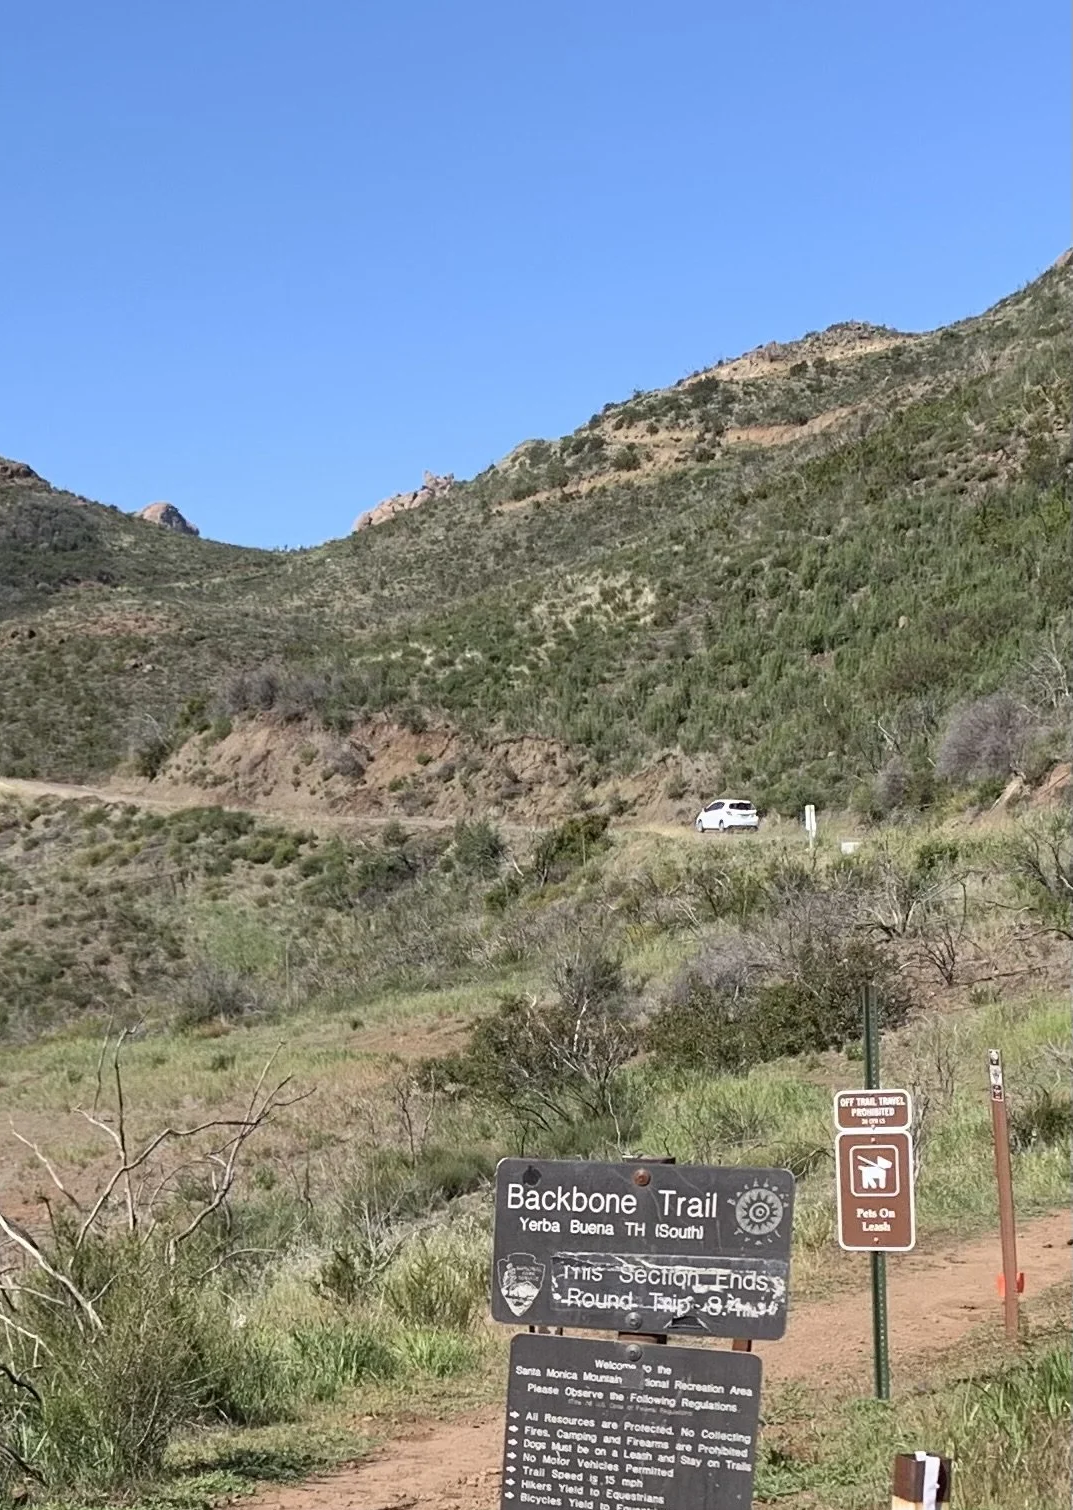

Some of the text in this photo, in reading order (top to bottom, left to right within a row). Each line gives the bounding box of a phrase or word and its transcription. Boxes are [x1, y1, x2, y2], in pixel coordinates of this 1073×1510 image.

[840, 1097, 905, 1107] OFF TRAIL TRAVEL
[851, 1108, 894, 1117] PROHIBITED
[507, 1183, 637, 1215] Backbone
[659, 1190, 717, 1219] Trail
[856, 1208, 895, 1218] Pets On
[519, 1217, 704, 1240] Yerba Buena TH (South)
[862, 1222, 890, 1232] Leash
[619, 1267, 699, 1289] Section
[716, 1271, 768, 1291] Ends
[567, 1288, 633, 1308] Round
[595, 1360, 672, 1375] Welcome to the
[515, 1366, 541, 1377] Santa
[546, 1369, 578, 1380] Monica
[583, 1372, 623, 1384] Mountain
[674, 1381, 724, 1394] Recreation
[730, 1386, 753, 1397] Area
[527, 1383, 559, 1395] Please
[565, 1387, 604, 1400] Observe
[610, 1392, 624, 1402] the
[630, 1393, 676, 1408] Following
[681, 1399, 738, 1413] Regulations
[525, 1412, 538, 1421] All
[544, 1414, 595, 1427] Resources
[601, 1421, 618, 1429] are
[681, 1427, 695, 1437] No
[701, 1430, 751, 1445] Collecting
[523, 1438, 752, 1472] Dogs Must be on a Leash and Stay on Trails
[556, 1429, 597, 1443] Camping
[603, 1435, 621, 1445] and
[627, 1437, 669, 1450] Firearms
[675, 1442, 692, 1452] are
[698, 1444, 748, 1458] Prohibited
[523, 1453, 675, 1478] No Motor Vehicles Permitted
[523, 1466, 643, 1488] Trail Speed is 15 mph
[520, 1492, 562, 1506] Bicycles
[568, 1498, 593, 1510] Yield
[521, 1479, 665, 1504] Hikers Yield to Equestrians
